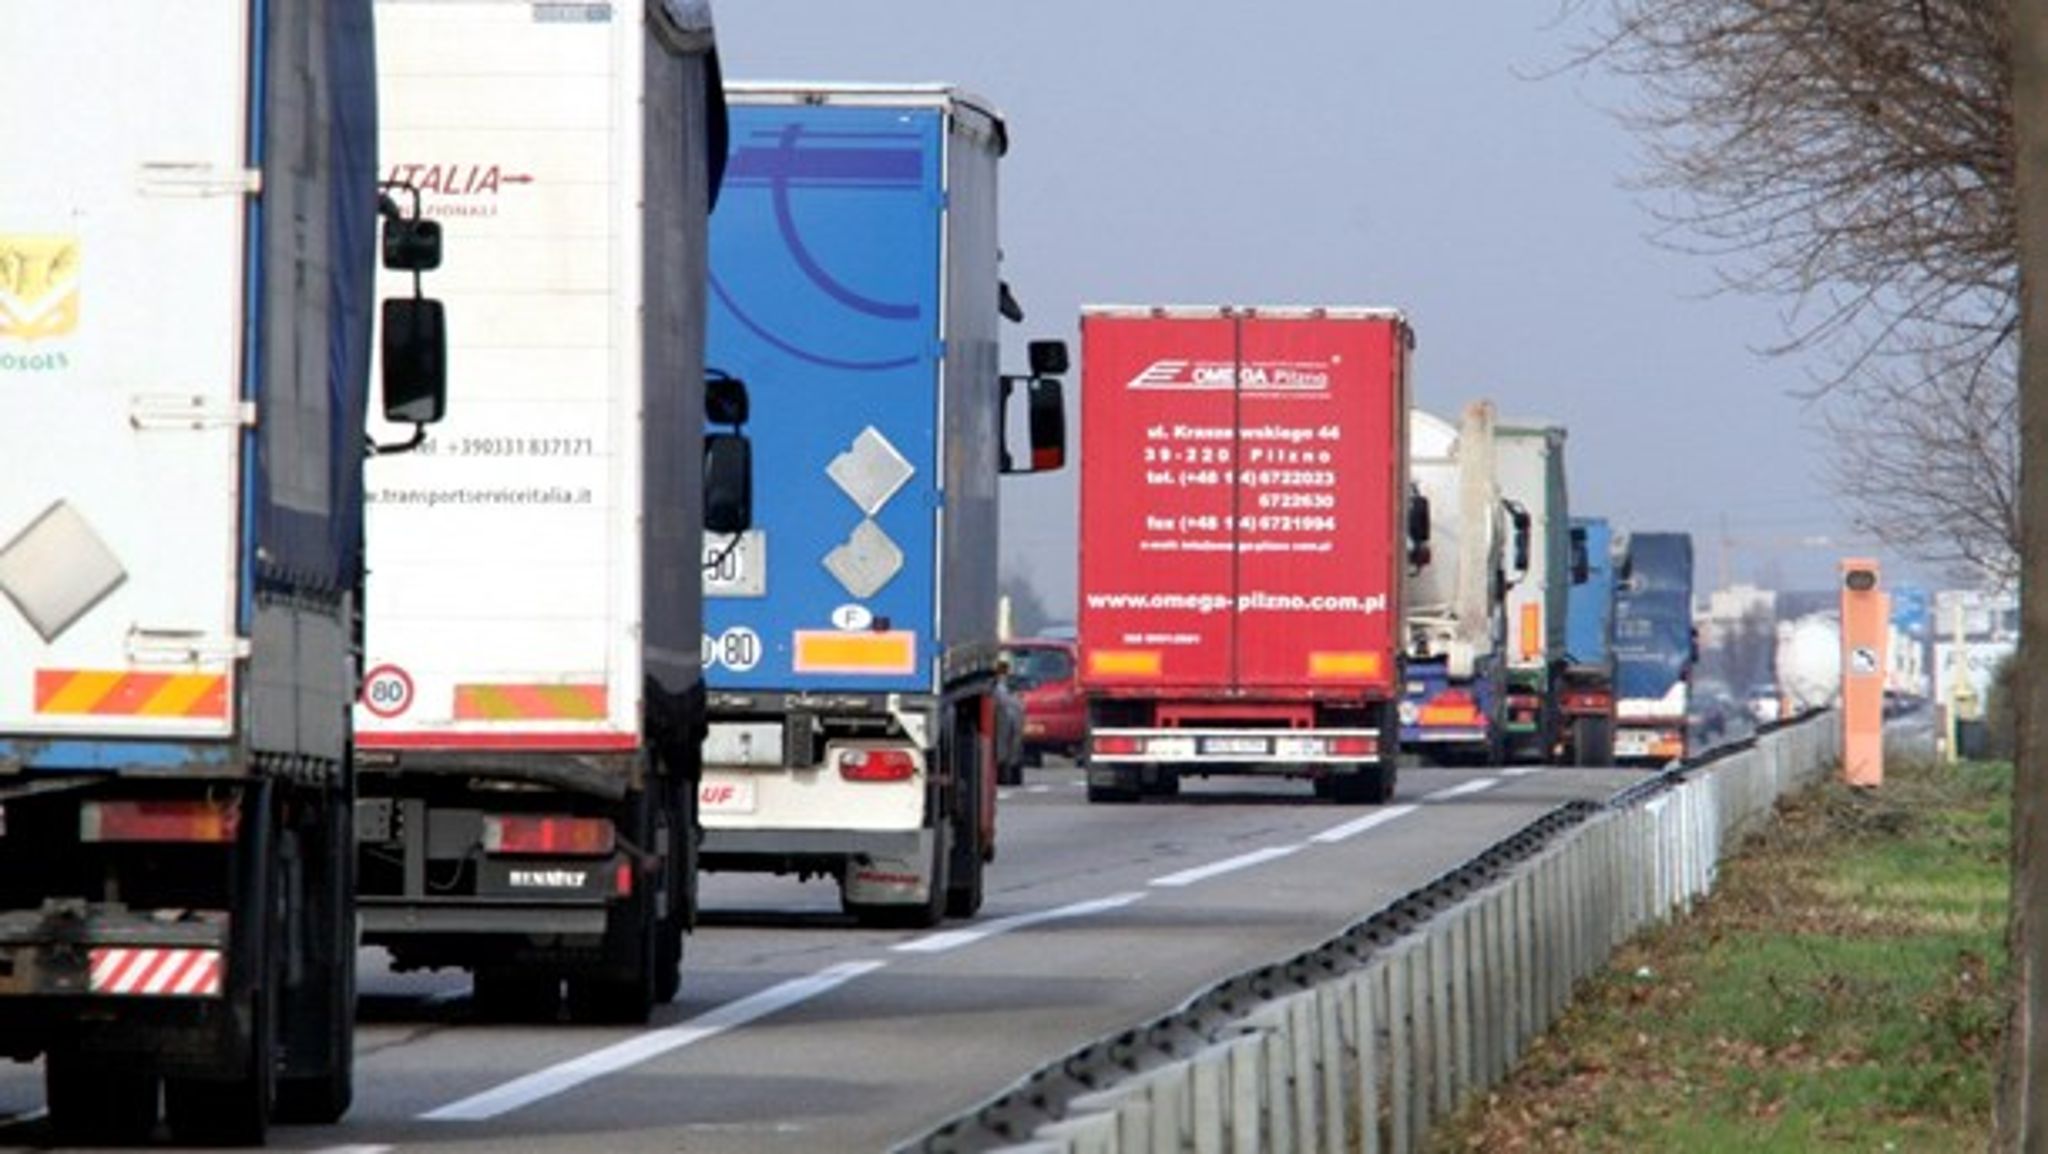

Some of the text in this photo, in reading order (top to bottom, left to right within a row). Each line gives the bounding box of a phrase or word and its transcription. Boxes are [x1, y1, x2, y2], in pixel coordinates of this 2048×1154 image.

[386, 164, 499, 194] ITALIA
[1147, 426, 1169, 439] ul.
[1318, 426, 1341, 439] 44
[1144, 447, 1332, 463] 39-220 Pilzno
[1147, 471, 1175, 484] tel.
[724, 633, 754, 665] 80
[372, 680, 404, 702] 80
